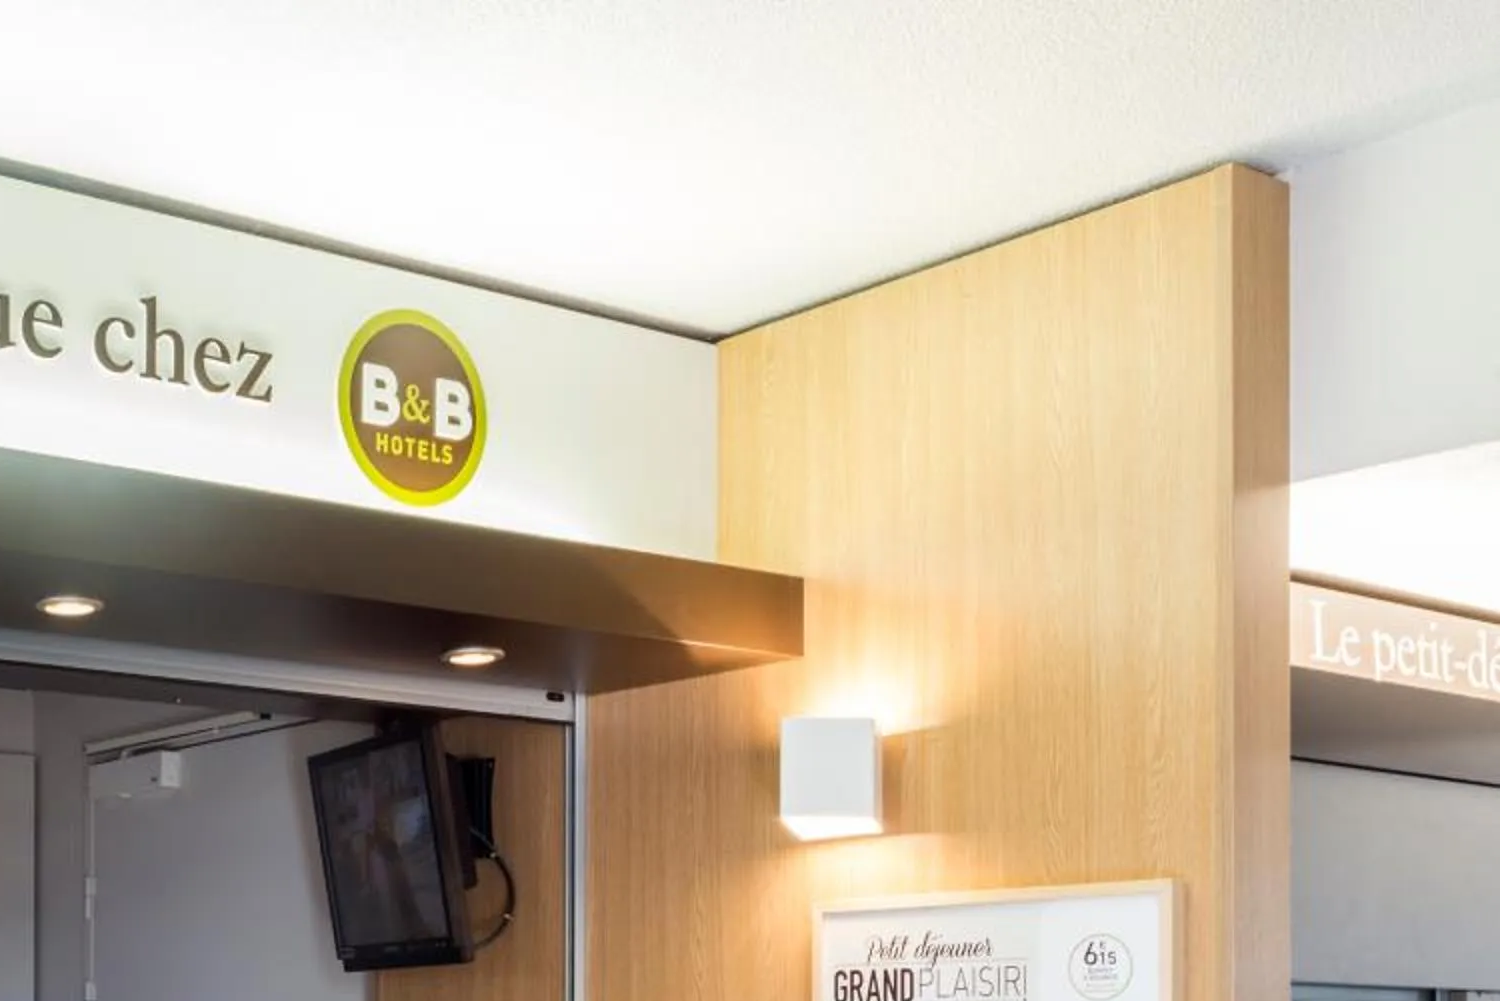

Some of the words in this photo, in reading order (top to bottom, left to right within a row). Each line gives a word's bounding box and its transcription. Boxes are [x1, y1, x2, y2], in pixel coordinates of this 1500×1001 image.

[92, 296, 275, 404] chez
[361, 362, 473, 441] B&B
[375, 431, 453, 465] HOTELS
[1308, 598, 1361, 667] Le
[866, 934, 909, 964] Petit
